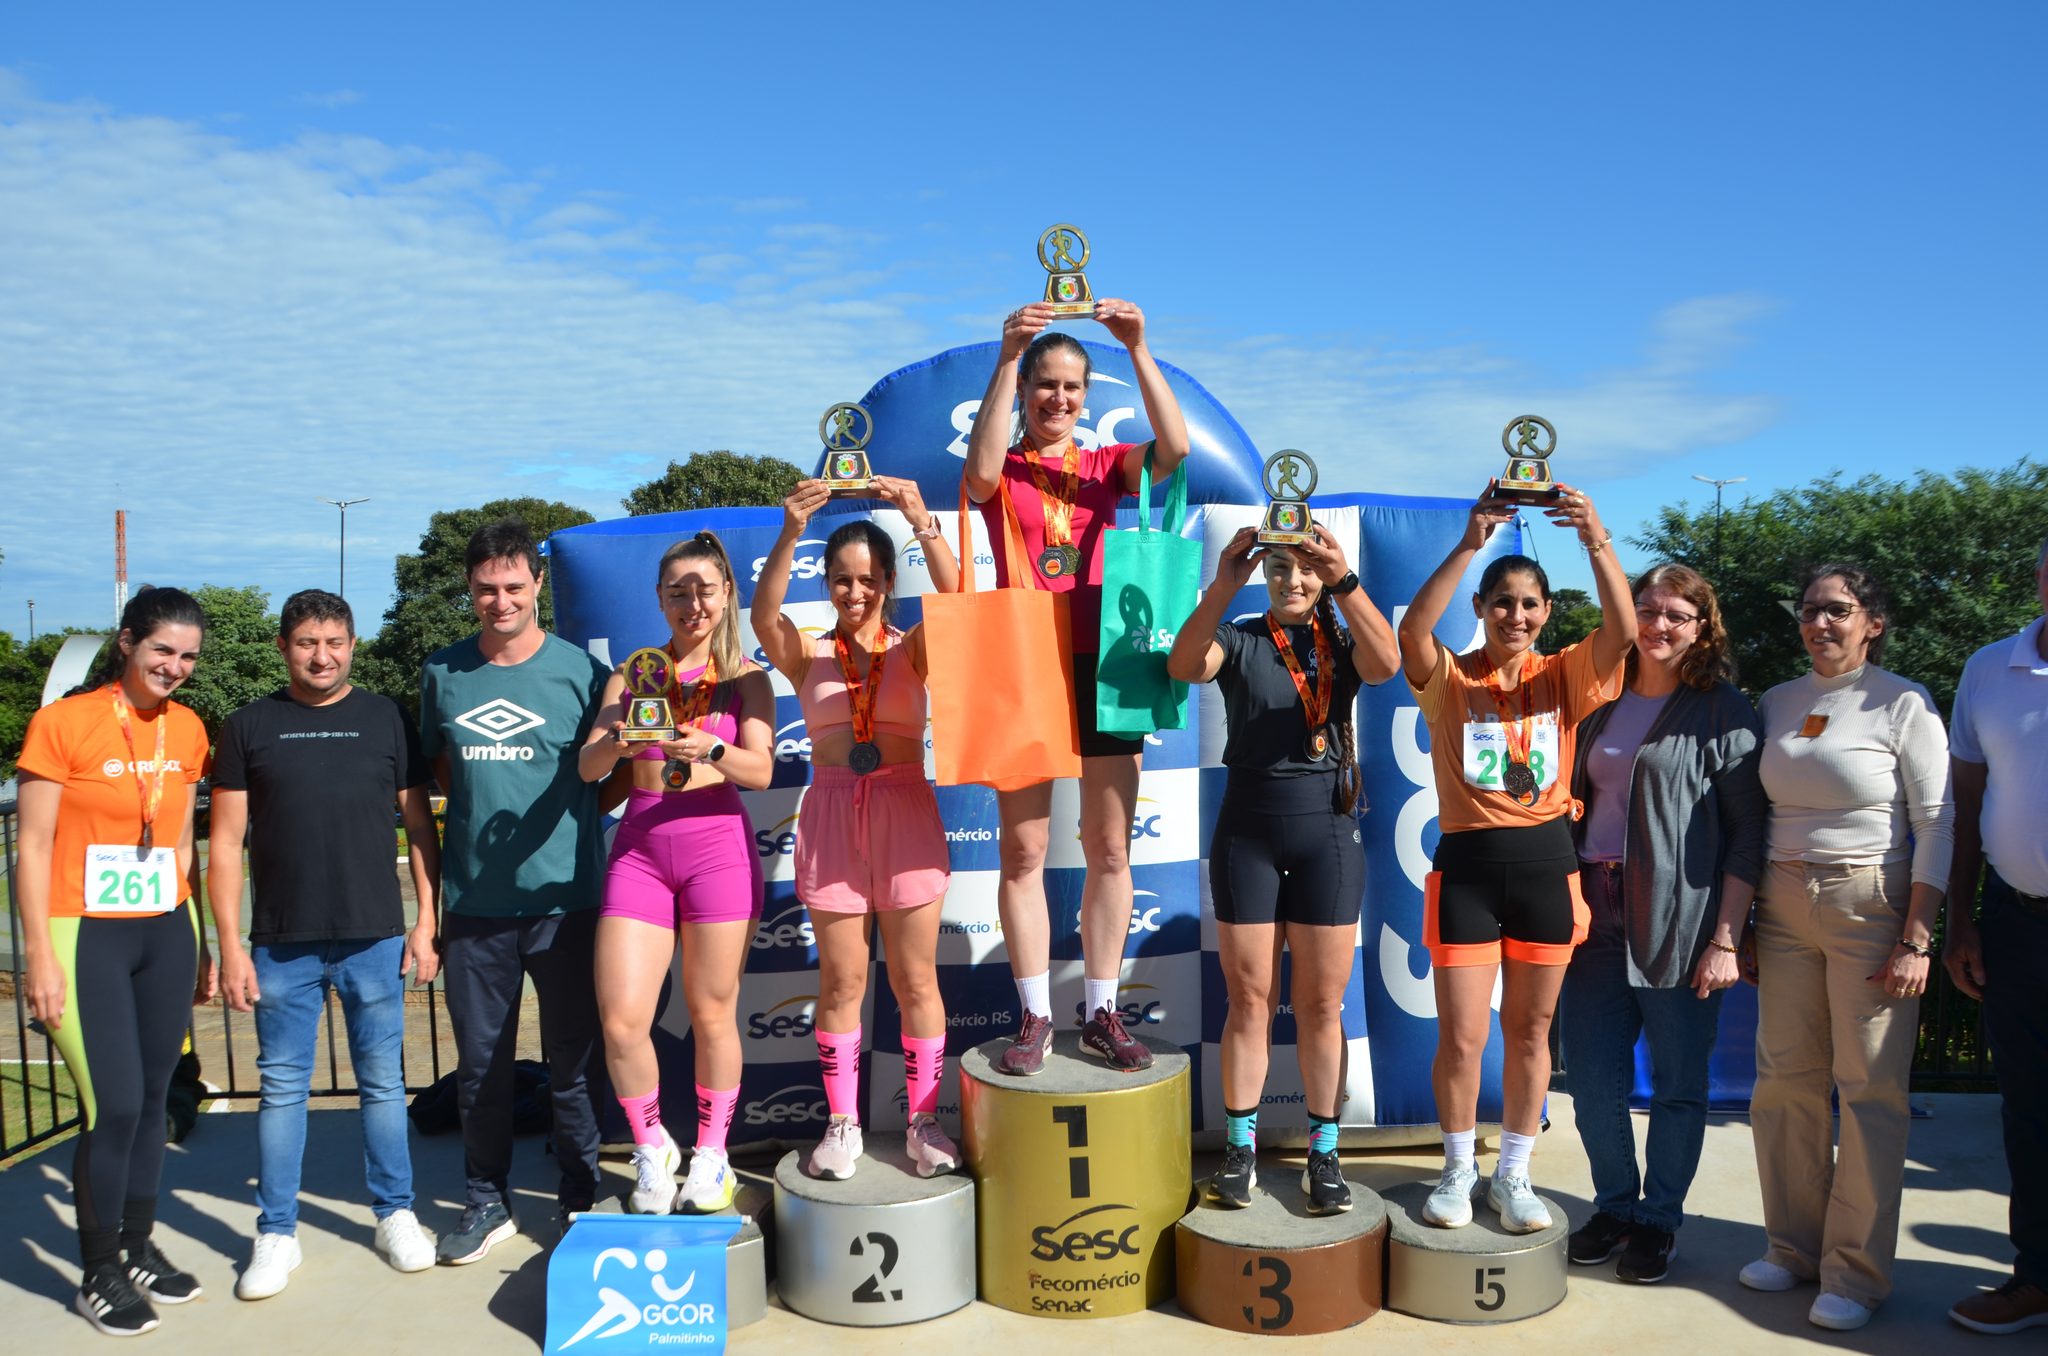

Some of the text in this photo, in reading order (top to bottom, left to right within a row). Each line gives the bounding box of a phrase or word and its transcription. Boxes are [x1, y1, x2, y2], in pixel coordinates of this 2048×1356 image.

[462, 742, 534, 761] umbro
[1477, 750, 1545, 785] 28
[945, 827, 992, 841] mércio
[97, 870, 161, 904] 261
[750, 921, 815, 949] Ses
[939, 921, 990, 934] mércio
[992, 1011, 1012, 1024] RS
[744, 1101, 826, 1125] Sesc
[1052, 1104, 1091, 1199] 1
[1030, 1224, 1140, 1261] Sesc
[849, 1231, 904, 1303] 2
[1029, 1270, 1141, 1292] Fecomércio
[1242, 1256, 1294, 1330] 3
[1474, 1267, 1506, 1311] 5
[643, 1303, 715, 1325] GCOR
[1031, 1296, 1092, 1313] Senac
[649, 1332, 715, 1344] Palmitinho
